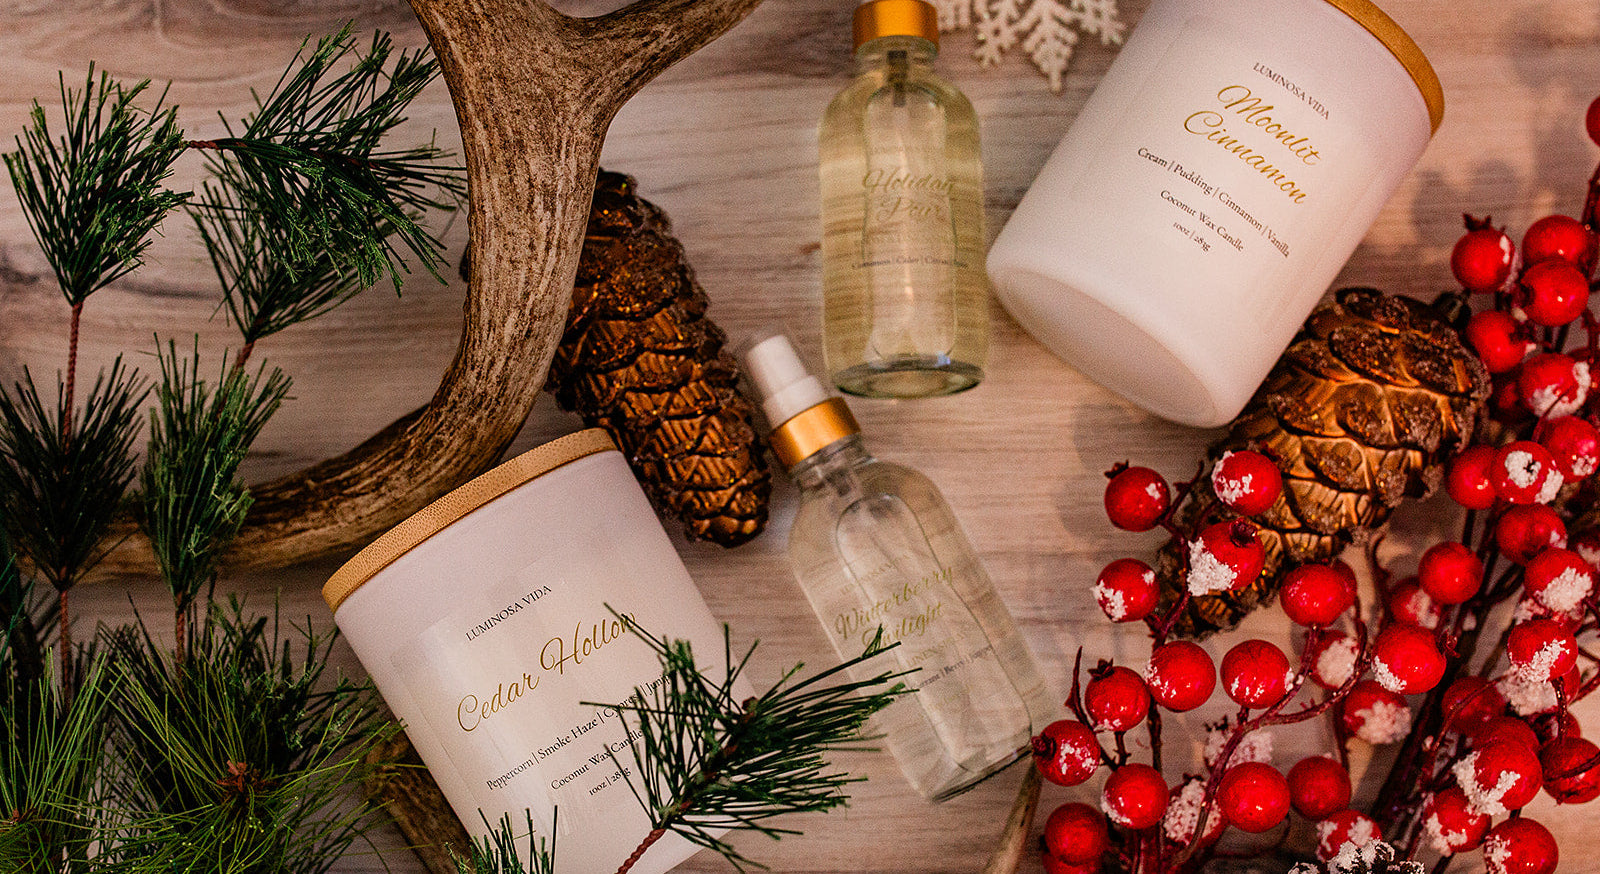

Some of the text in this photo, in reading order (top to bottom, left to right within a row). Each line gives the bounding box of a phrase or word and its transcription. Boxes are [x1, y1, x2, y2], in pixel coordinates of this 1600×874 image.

[1253, 62, 1330, 121] LUMINOSA VIDA
[1184, 110, 1307, 204] Cinnamon
[1217, 85, 1321, 166] Moonlit
[1137, 147, 1168, 168] Cream
[1173, 164, 1213, 195] Pudding
[1218, 191, 1263, 232] Cinnamon
[1267, 229, 1290, 258] Vanilla
[1160, 190, 1244, 252] Coconut Wax Candle
[465, 585, 552, 641] LUMINOSA VIDA
[834, 567, 952, 640] Winterberry
[457, 672, 540, 732] Cedar
[486, 758, 534, 791] Peppercorn
[537, 736, 572, 760] Smoke
[570, 718, 599, 739] Haze
[551, 764, 590, 790] Coconut
[588, 750, 612, 766] Wax
